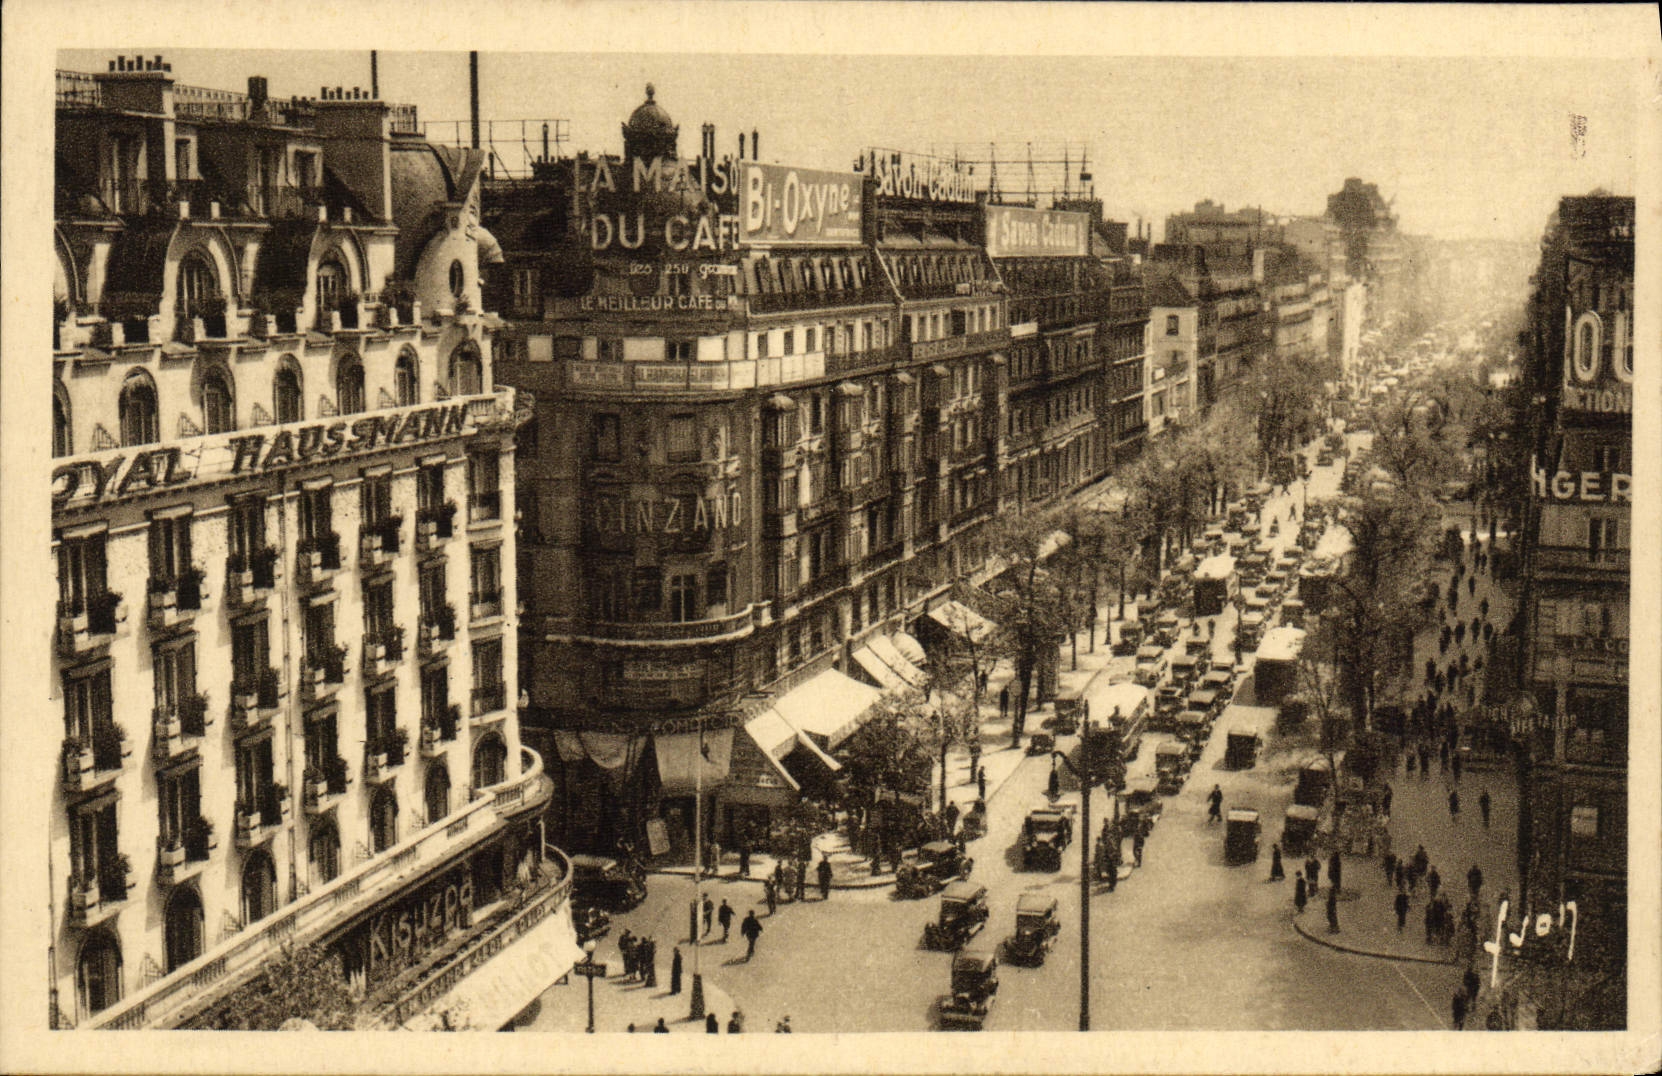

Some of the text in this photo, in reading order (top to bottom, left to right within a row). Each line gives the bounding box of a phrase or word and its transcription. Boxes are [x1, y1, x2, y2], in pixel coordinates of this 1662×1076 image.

[574, 155, 617, 194] LA
[591, 213, 646, 250] DU
[598, 295, 674, 311] MEILLEUR
[230, 402, 468, 474] HAUSSMANN
